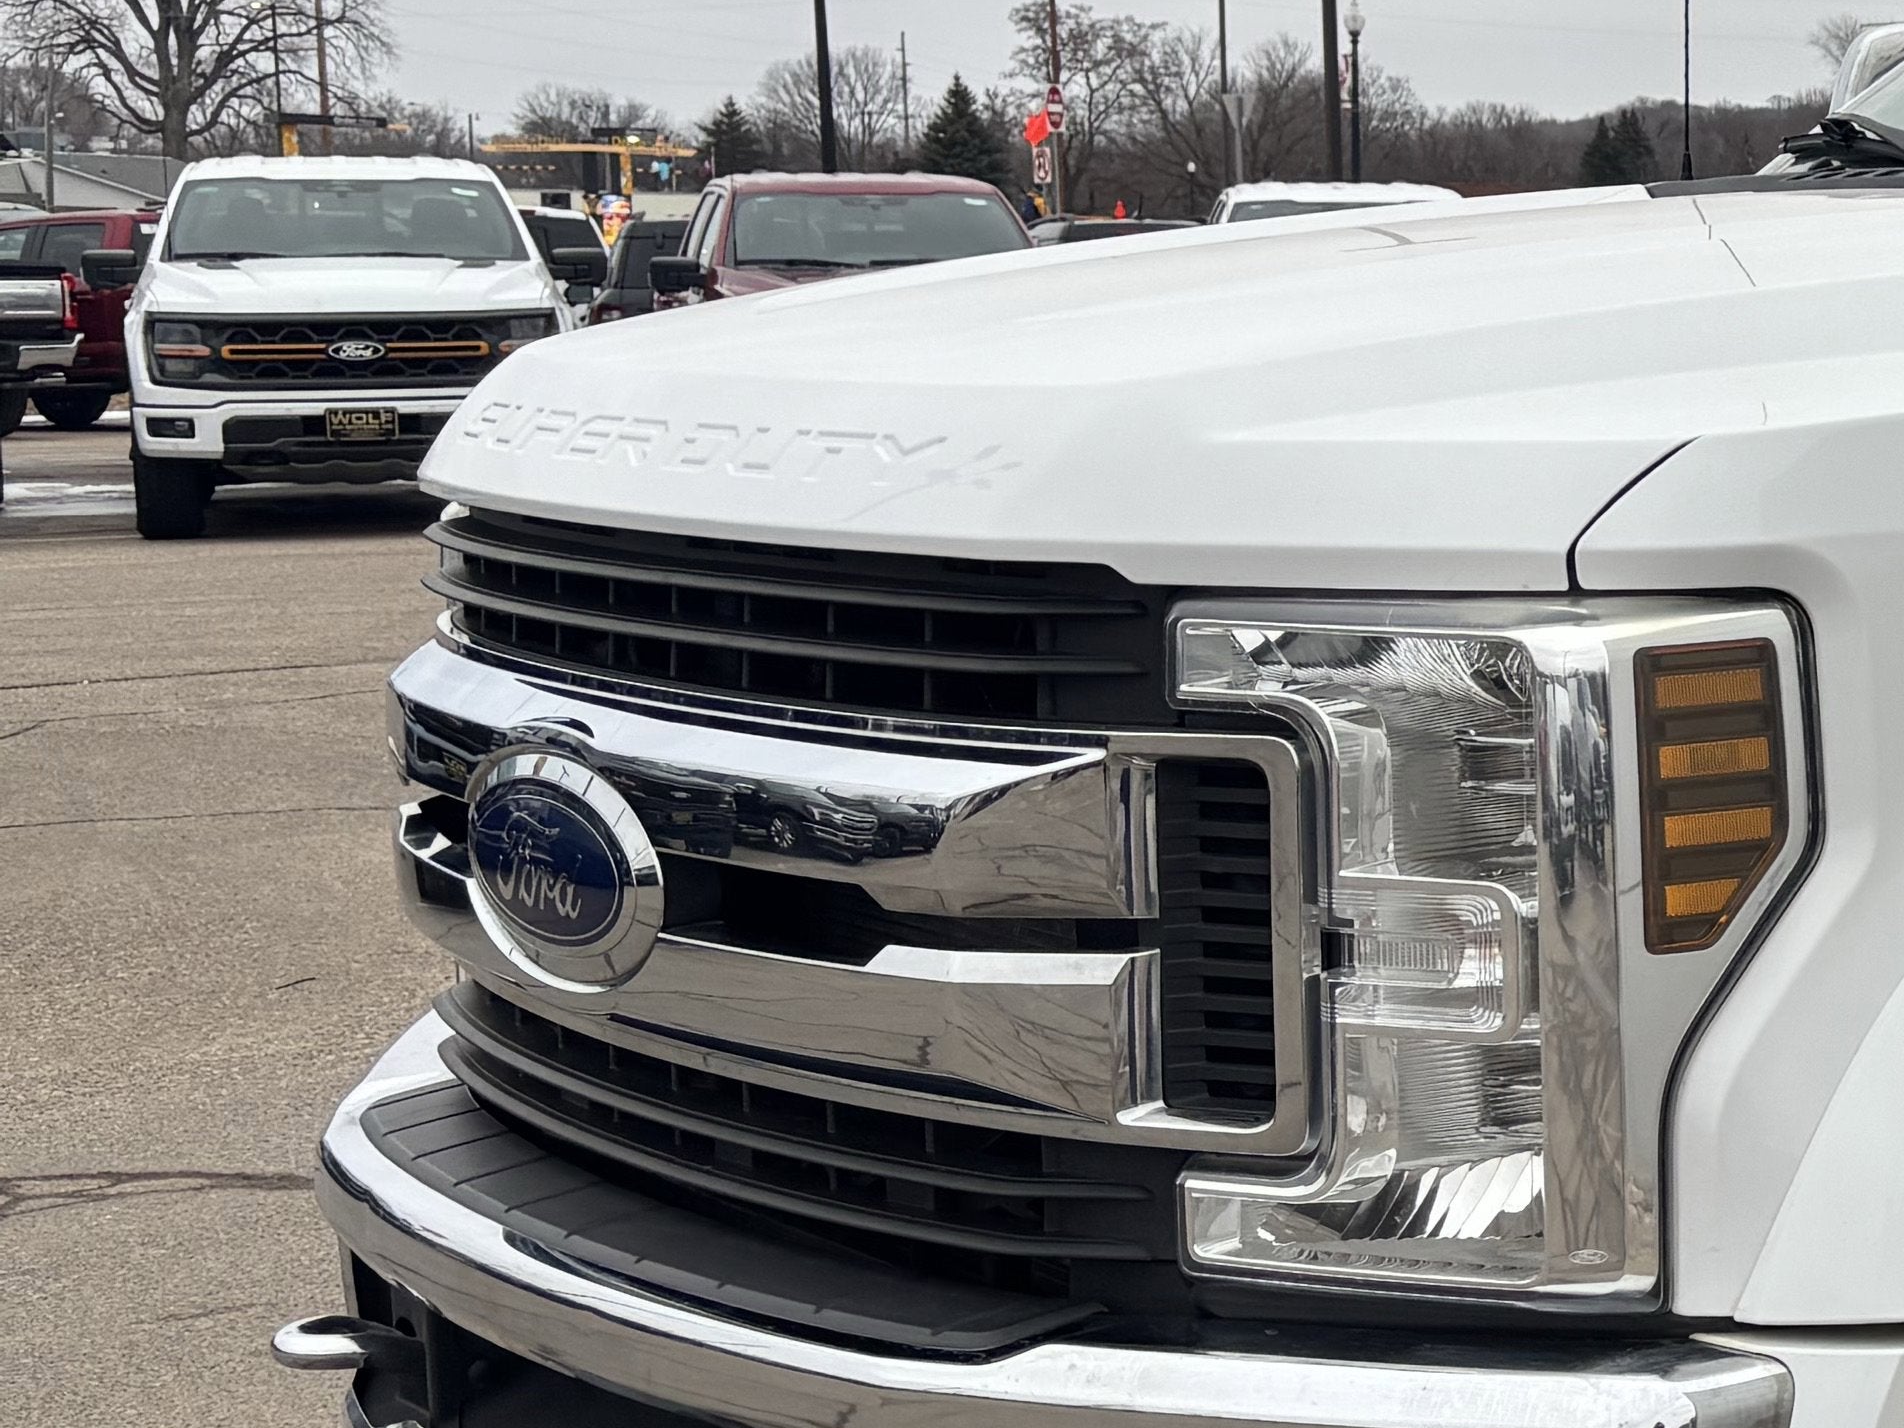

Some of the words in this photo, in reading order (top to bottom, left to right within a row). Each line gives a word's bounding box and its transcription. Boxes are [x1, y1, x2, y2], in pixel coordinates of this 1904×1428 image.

[331, 410, 393, 424] WOLF
[462, 401, 669, 468] SUPER
[663, 420, 949, 487] DUTY
